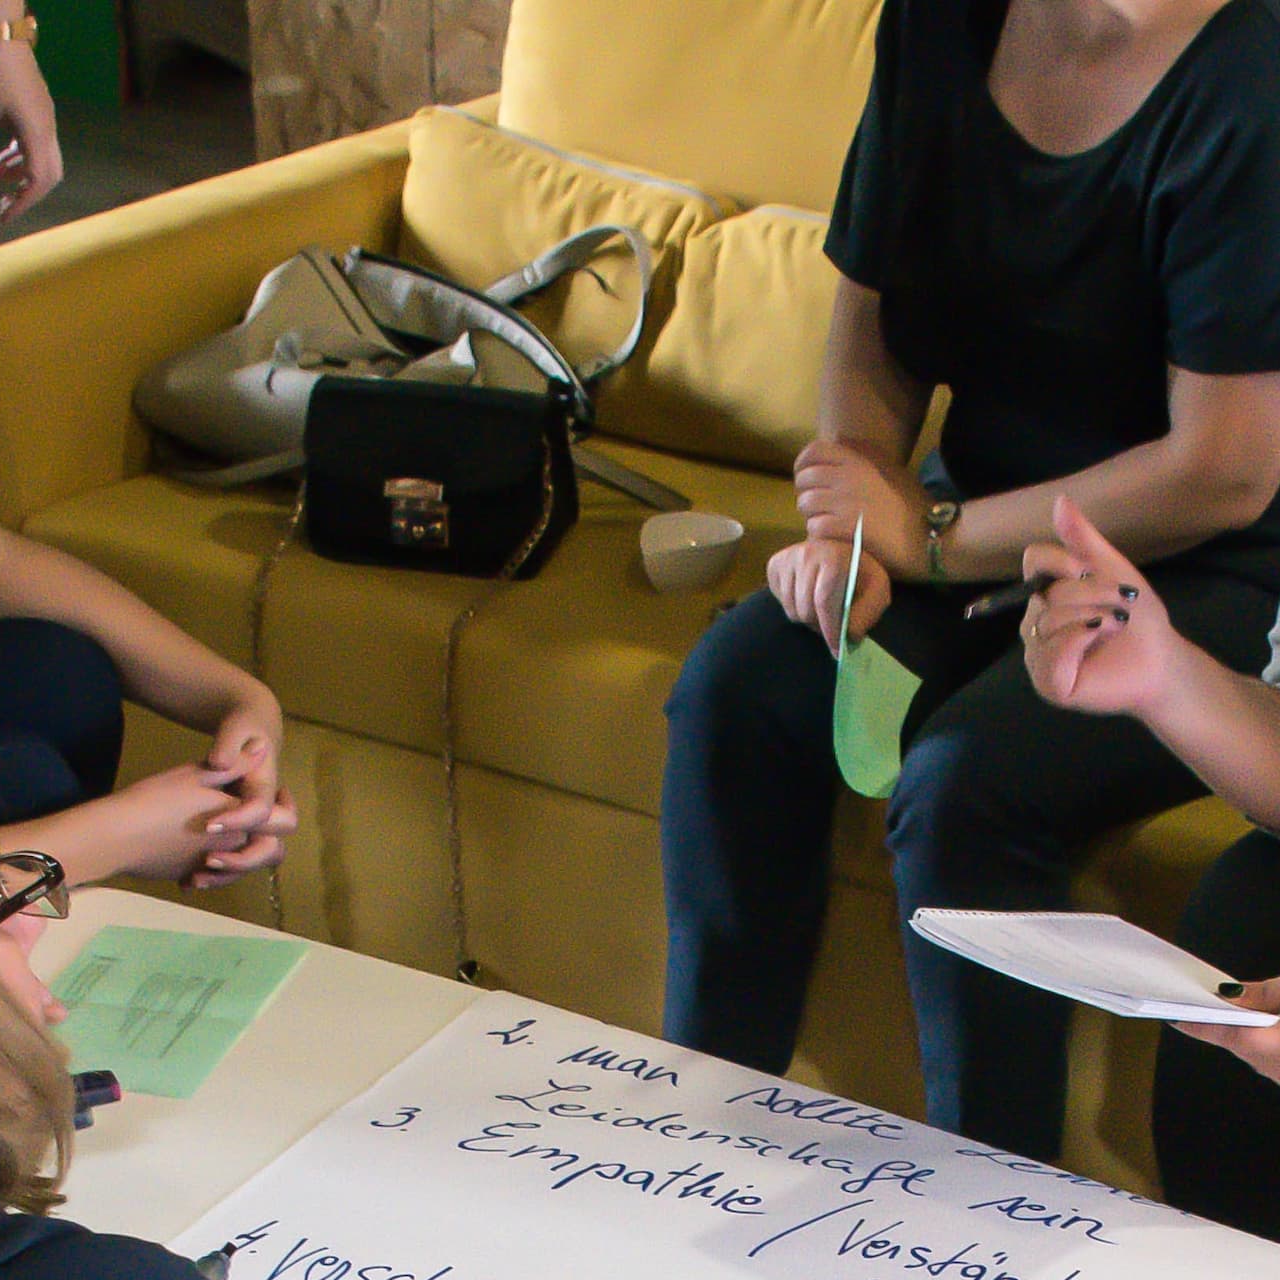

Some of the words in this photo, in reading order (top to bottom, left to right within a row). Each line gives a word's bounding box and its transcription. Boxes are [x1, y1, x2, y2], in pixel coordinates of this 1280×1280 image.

[556, 1045, 680, 1088] man
[724, 1086, 904, 1141] sollte
[456, 1121, 767, 1216] Empathie
[494, 1078, 937, 1197] Leidenschaft
[967, 1195, 1117, 1245] sein
